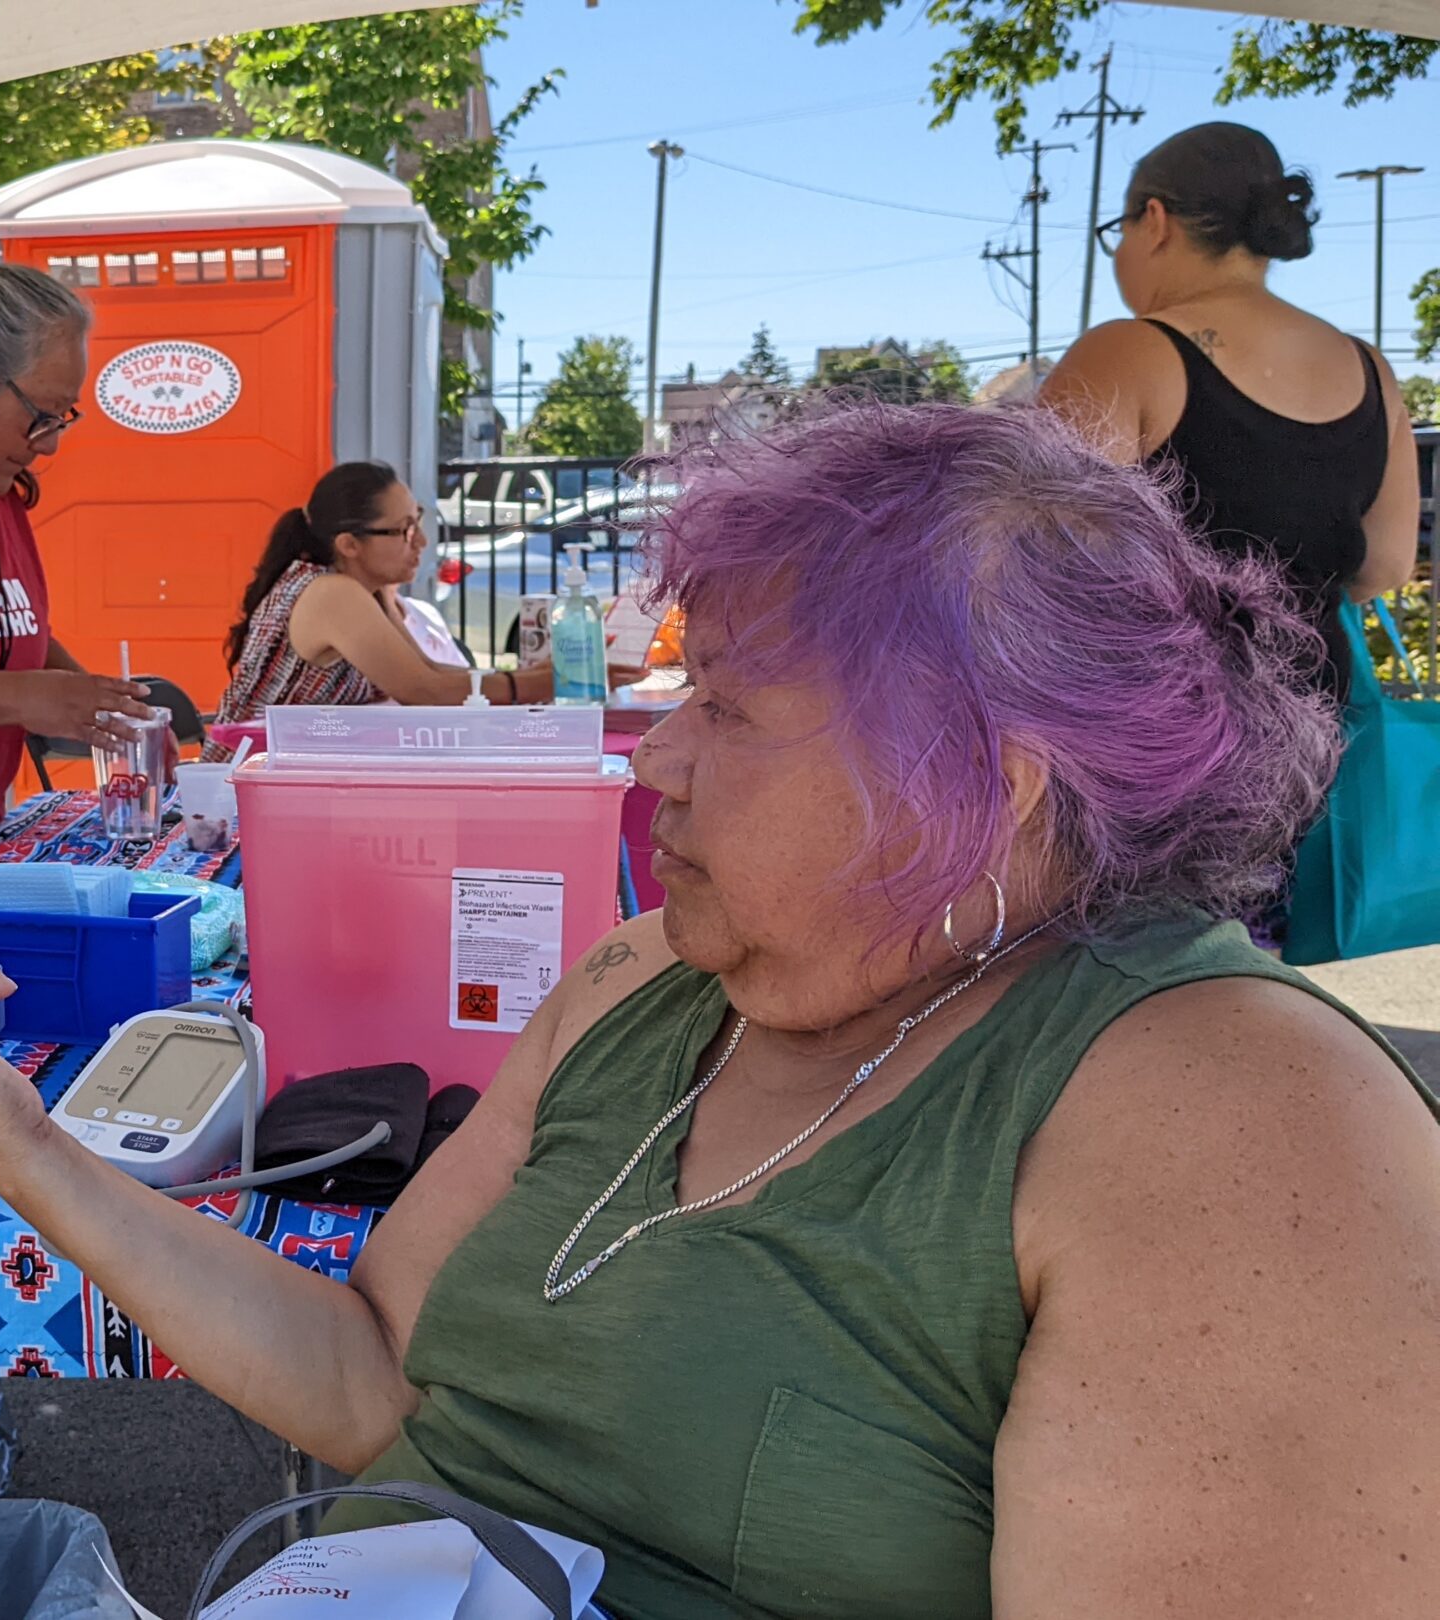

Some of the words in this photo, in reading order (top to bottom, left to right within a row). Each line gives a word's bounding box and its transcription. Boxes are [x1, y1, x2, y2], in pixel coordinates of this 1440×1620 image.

[122, 356, 165, 380] STOP
[170, 355, 181, 367] N
[187, 357, 212, 375] GO
[132, 373, 203, 389] PORTABLES
[112, 390, 222, 421] 414-778-4161
[105, 773, 148, 799] ADP
[350, 836, 437, 866] FULL
[467, 889, 508, 898] PREVENT
[459, 900, 494, 908] Biohazard
[496, 902, 529, 910] Infectious
[174, 1023, 217, 1035] OMRON
